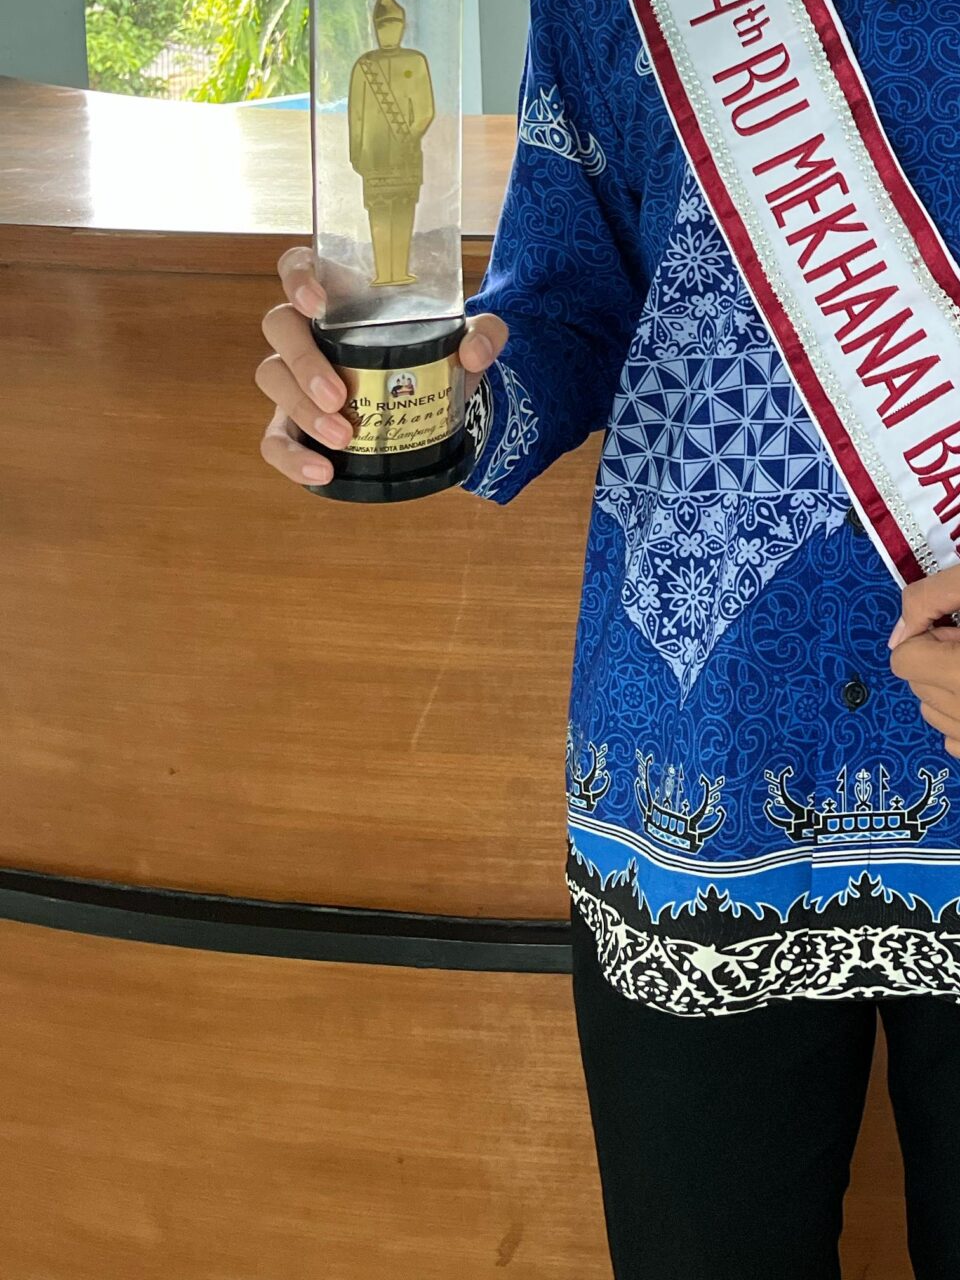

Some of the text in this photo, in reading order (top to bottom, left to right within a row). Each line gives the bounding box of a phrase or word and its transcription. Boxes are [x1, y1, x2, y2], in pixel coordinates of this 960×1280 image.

[712, 41, 810, 137] RU
[752, 132, 955, 429] MEKHANAI
[350, 386, 452, 411] 4th RUNNER UP
[384, 425, 436, 441] Lampung
[399, 440, 426, 451] BANDAR
